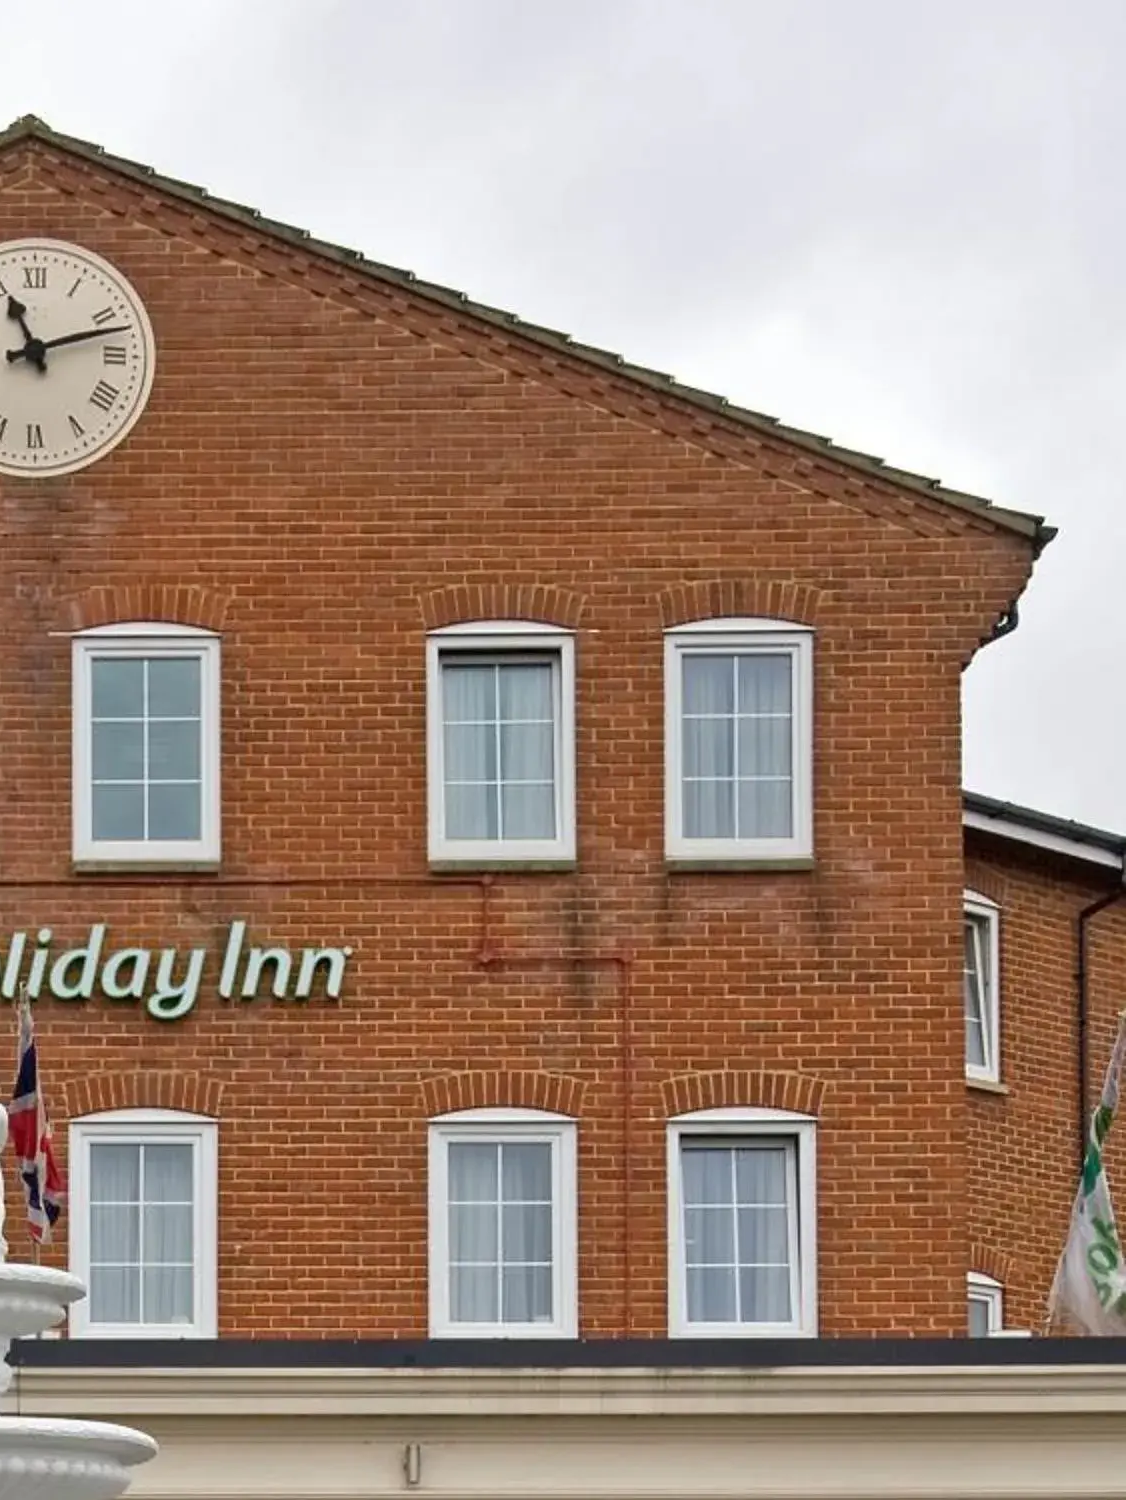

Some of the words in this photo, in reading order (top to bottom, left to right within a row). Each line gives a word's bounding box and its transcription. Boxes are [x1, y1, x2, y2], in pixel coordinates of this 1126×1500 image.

[23, 267, 47, 288] XII
[67, 278, 82, 297] I
[91, 306, 117, 325] II
[103, 346, 126, 366] III
[27, 424, 44, 449] VI
[68, 415, 85, 438] V
[219, 920, 346, 998] Inn
